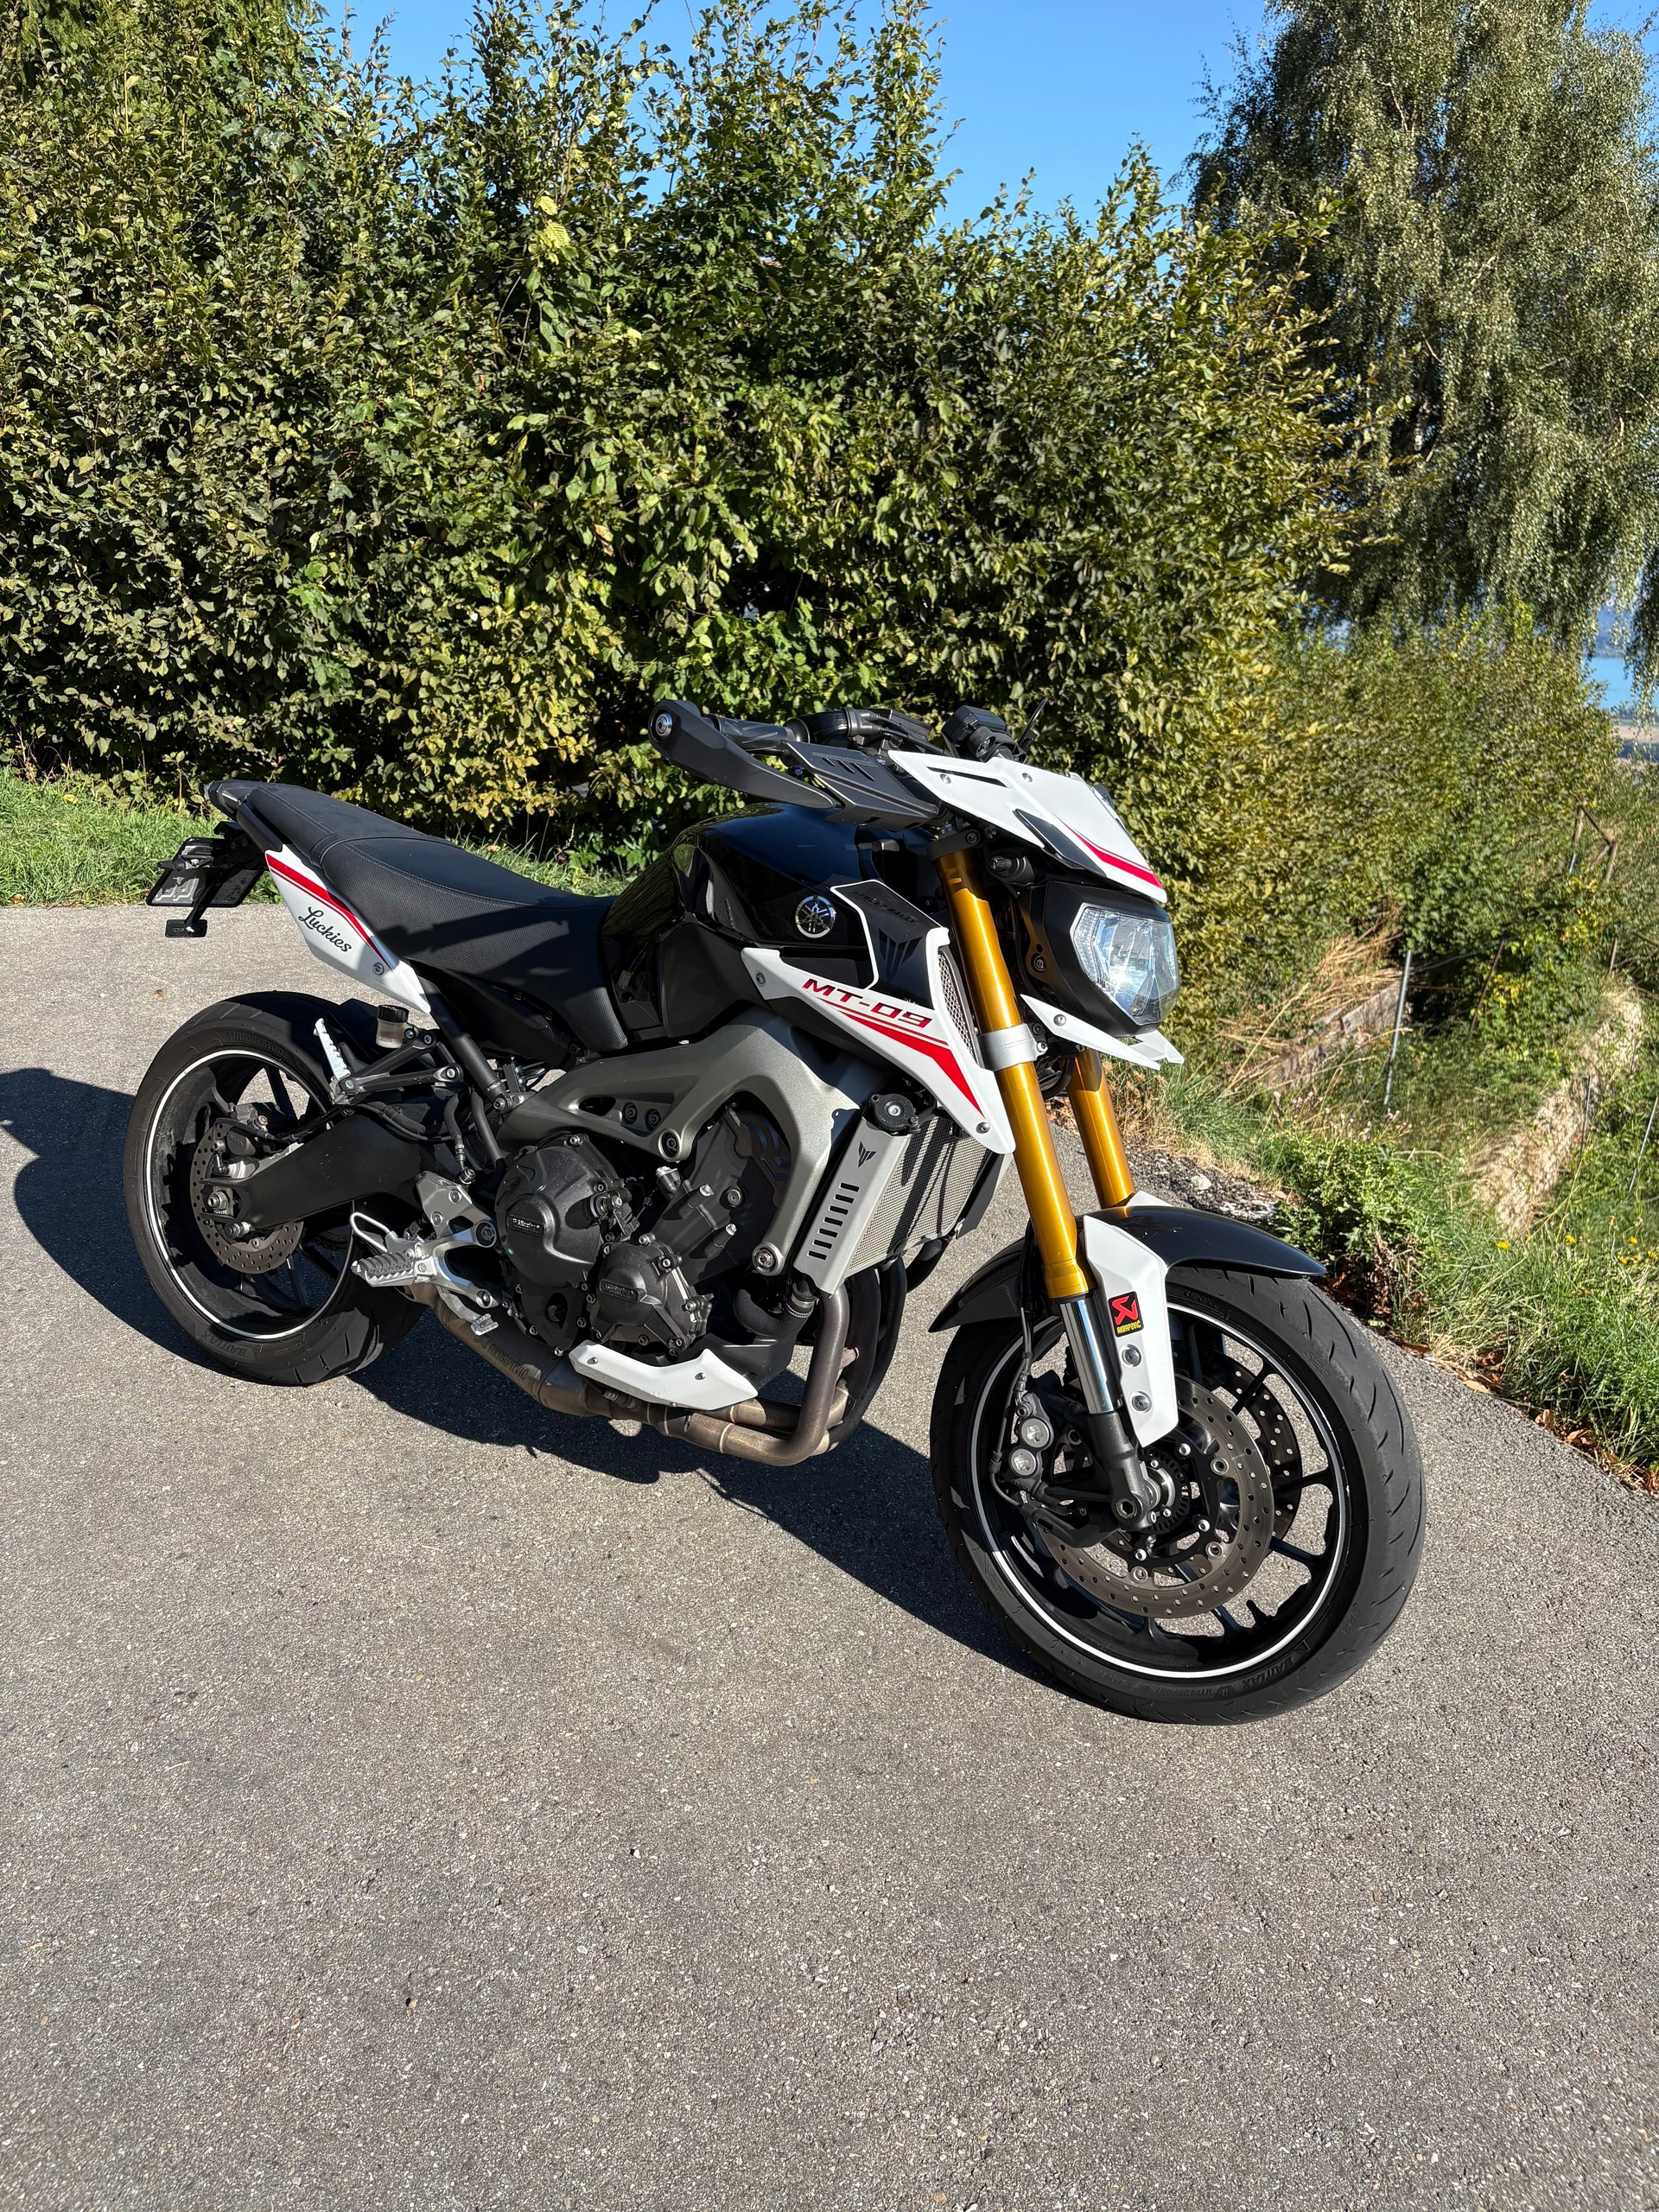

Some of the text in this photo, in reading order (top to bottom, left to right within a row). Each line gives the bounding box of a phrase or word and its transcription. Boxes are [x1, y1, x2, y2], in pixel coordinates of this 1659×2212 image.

[298, 906, 352, 952] Luckies
[887, 907, 918, 924] RALLY
[803, 978, 933, 1028] MT-09
